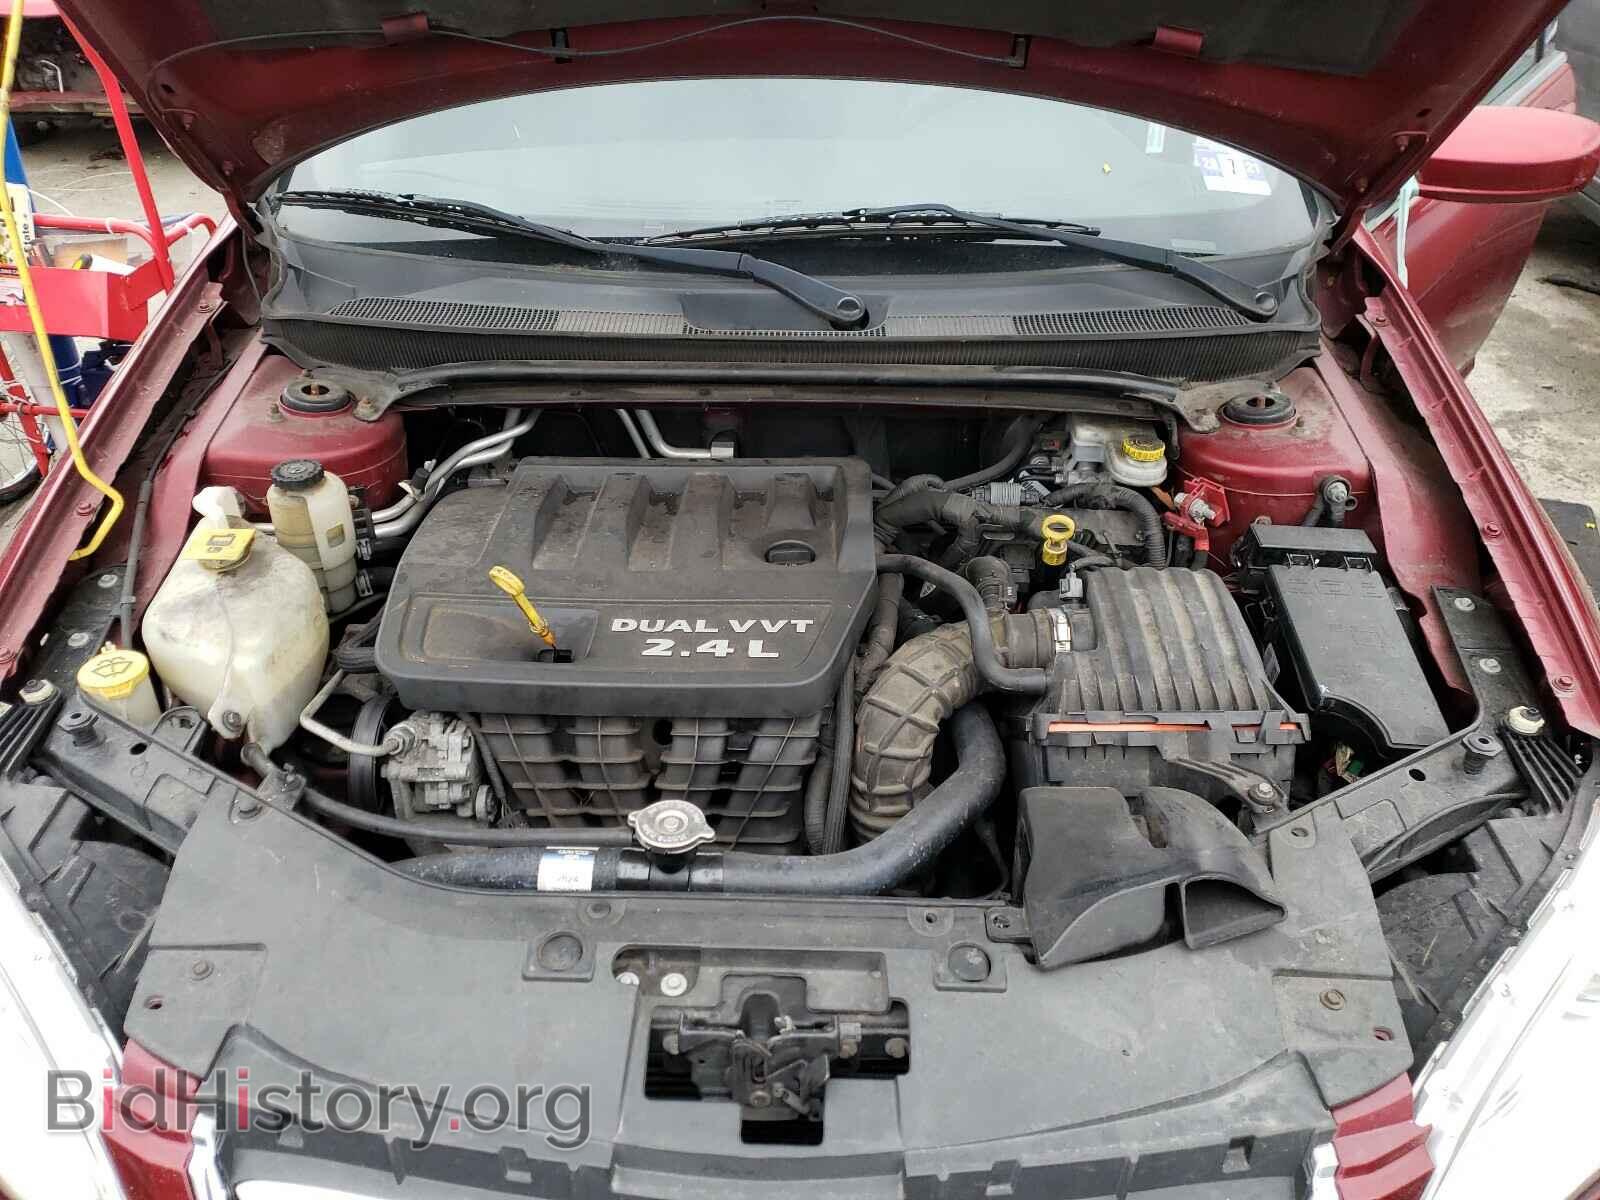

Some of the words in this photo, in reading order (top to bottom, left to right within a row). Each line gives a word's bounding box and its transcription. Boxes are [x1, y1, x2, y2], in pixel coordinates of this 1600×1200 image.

[611, 618, 719, 633] DUAL
[728, 618, 814, 633] VVT
[641, 638, 735, 657] 2.4
[748, 639, 779, 658] L
